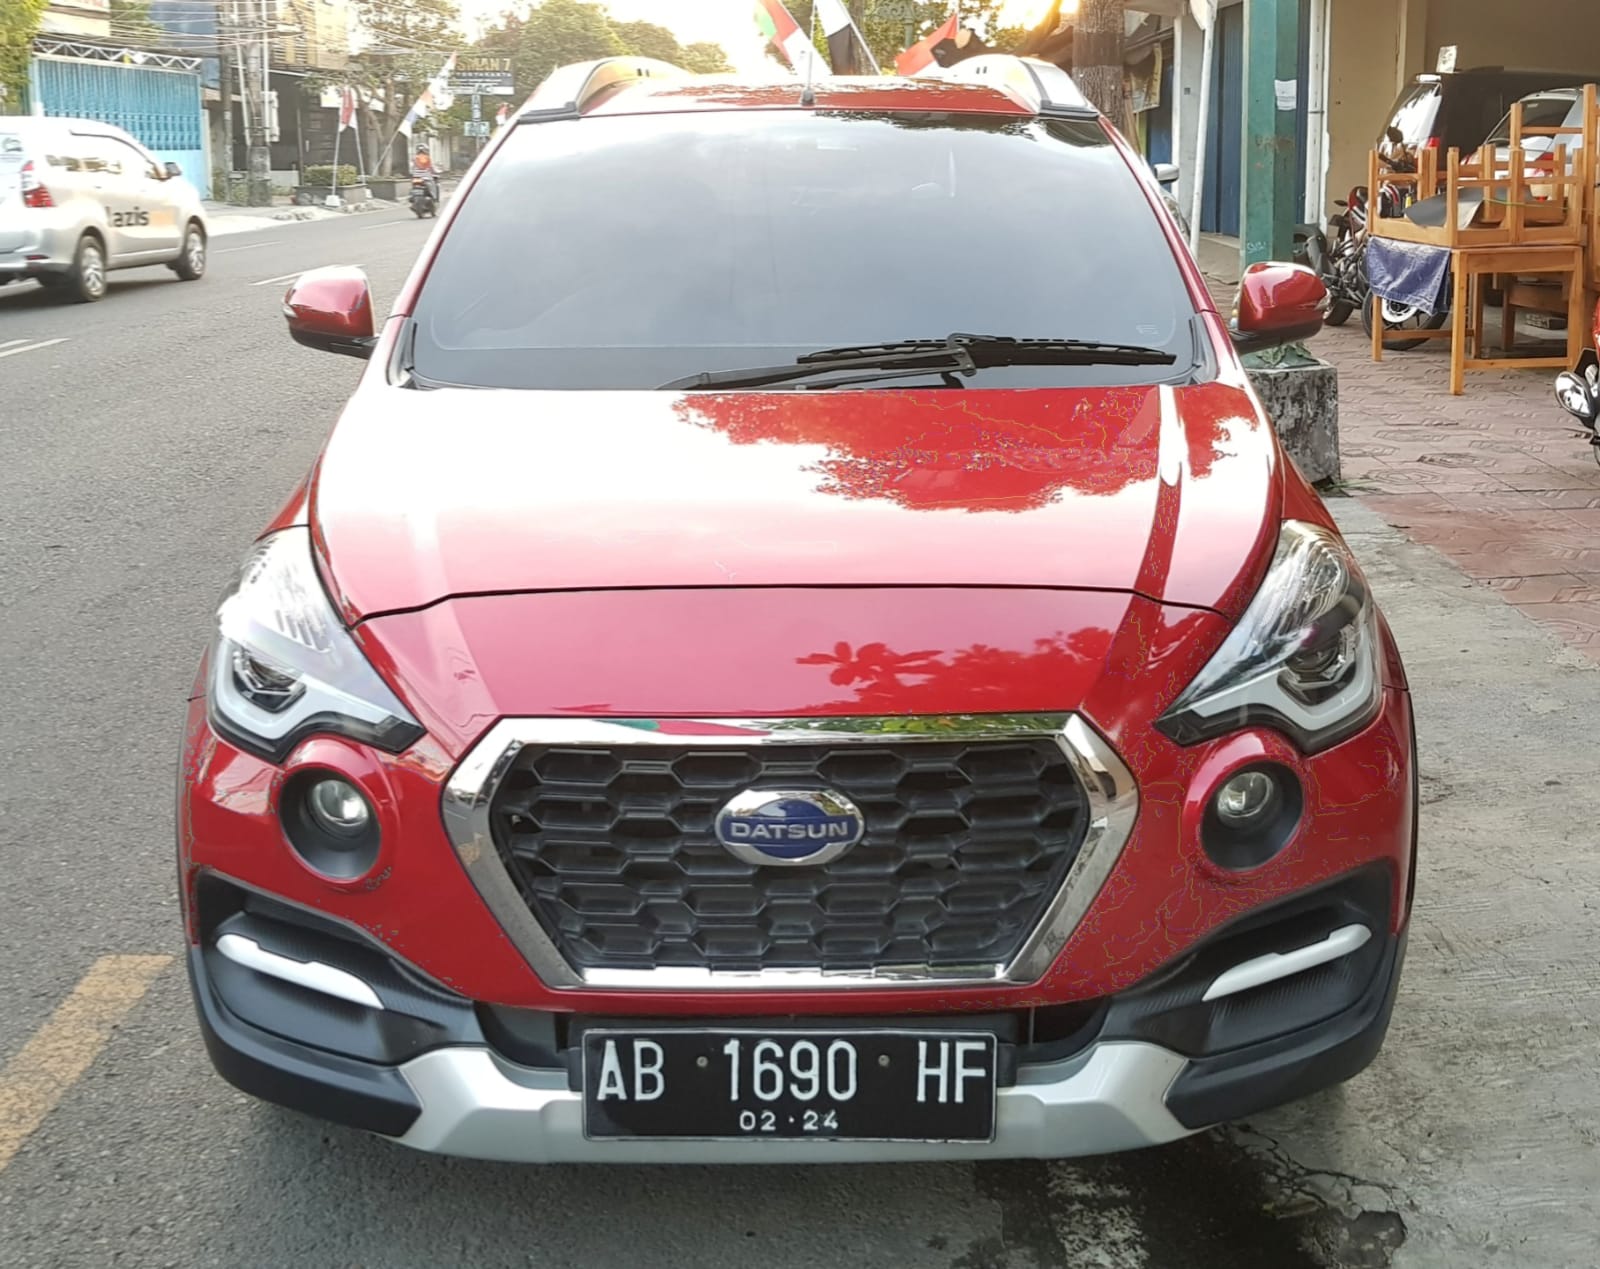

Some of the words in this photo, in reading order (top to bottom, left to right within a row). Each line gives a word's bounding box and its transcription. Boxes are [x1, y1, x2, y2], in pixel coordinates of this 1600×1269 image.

[503, 58, 511, 71] 7
[730, 821, 848, 839] DATSUN
[597, 1039, 664, 1101] AB
[723, 1039, 857, 1101] 1690
[917, 1040, 986, 1103] HF
